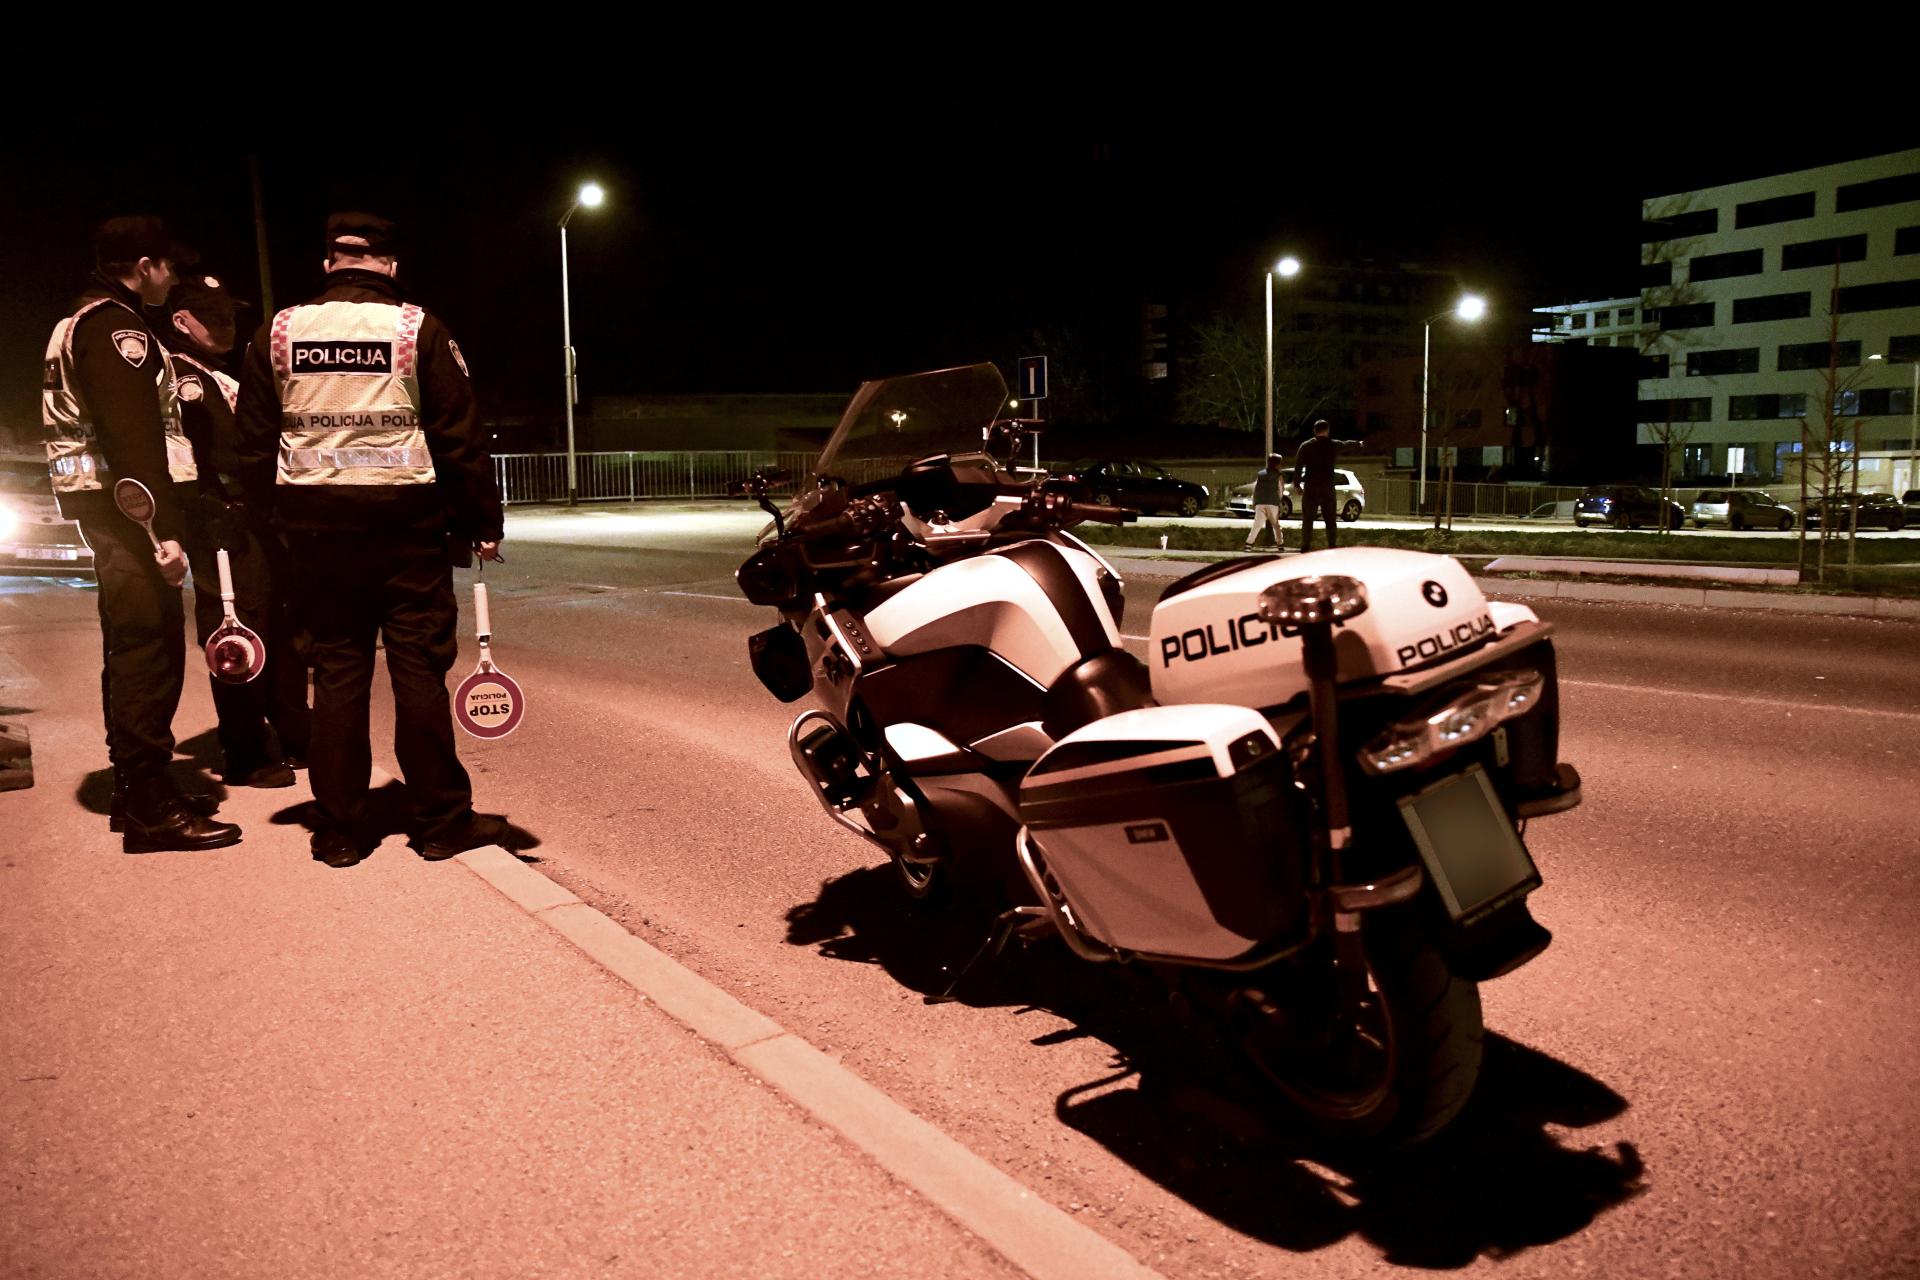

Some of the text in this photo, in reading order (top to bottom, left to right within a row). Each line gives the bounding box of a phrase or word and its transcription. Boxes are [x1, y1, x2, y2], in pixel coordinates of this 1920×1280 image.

[295, 347, 387, 366] POLICIJA
[310, 414, 374, 428] POLICIJA
[1161, 612, 1345, 669] POLICI
[1397, 614, 1497, 667] POLICIJA
[470, 692, 507, 701] POLICIJA
[469, 703, 510, 717] STOP
